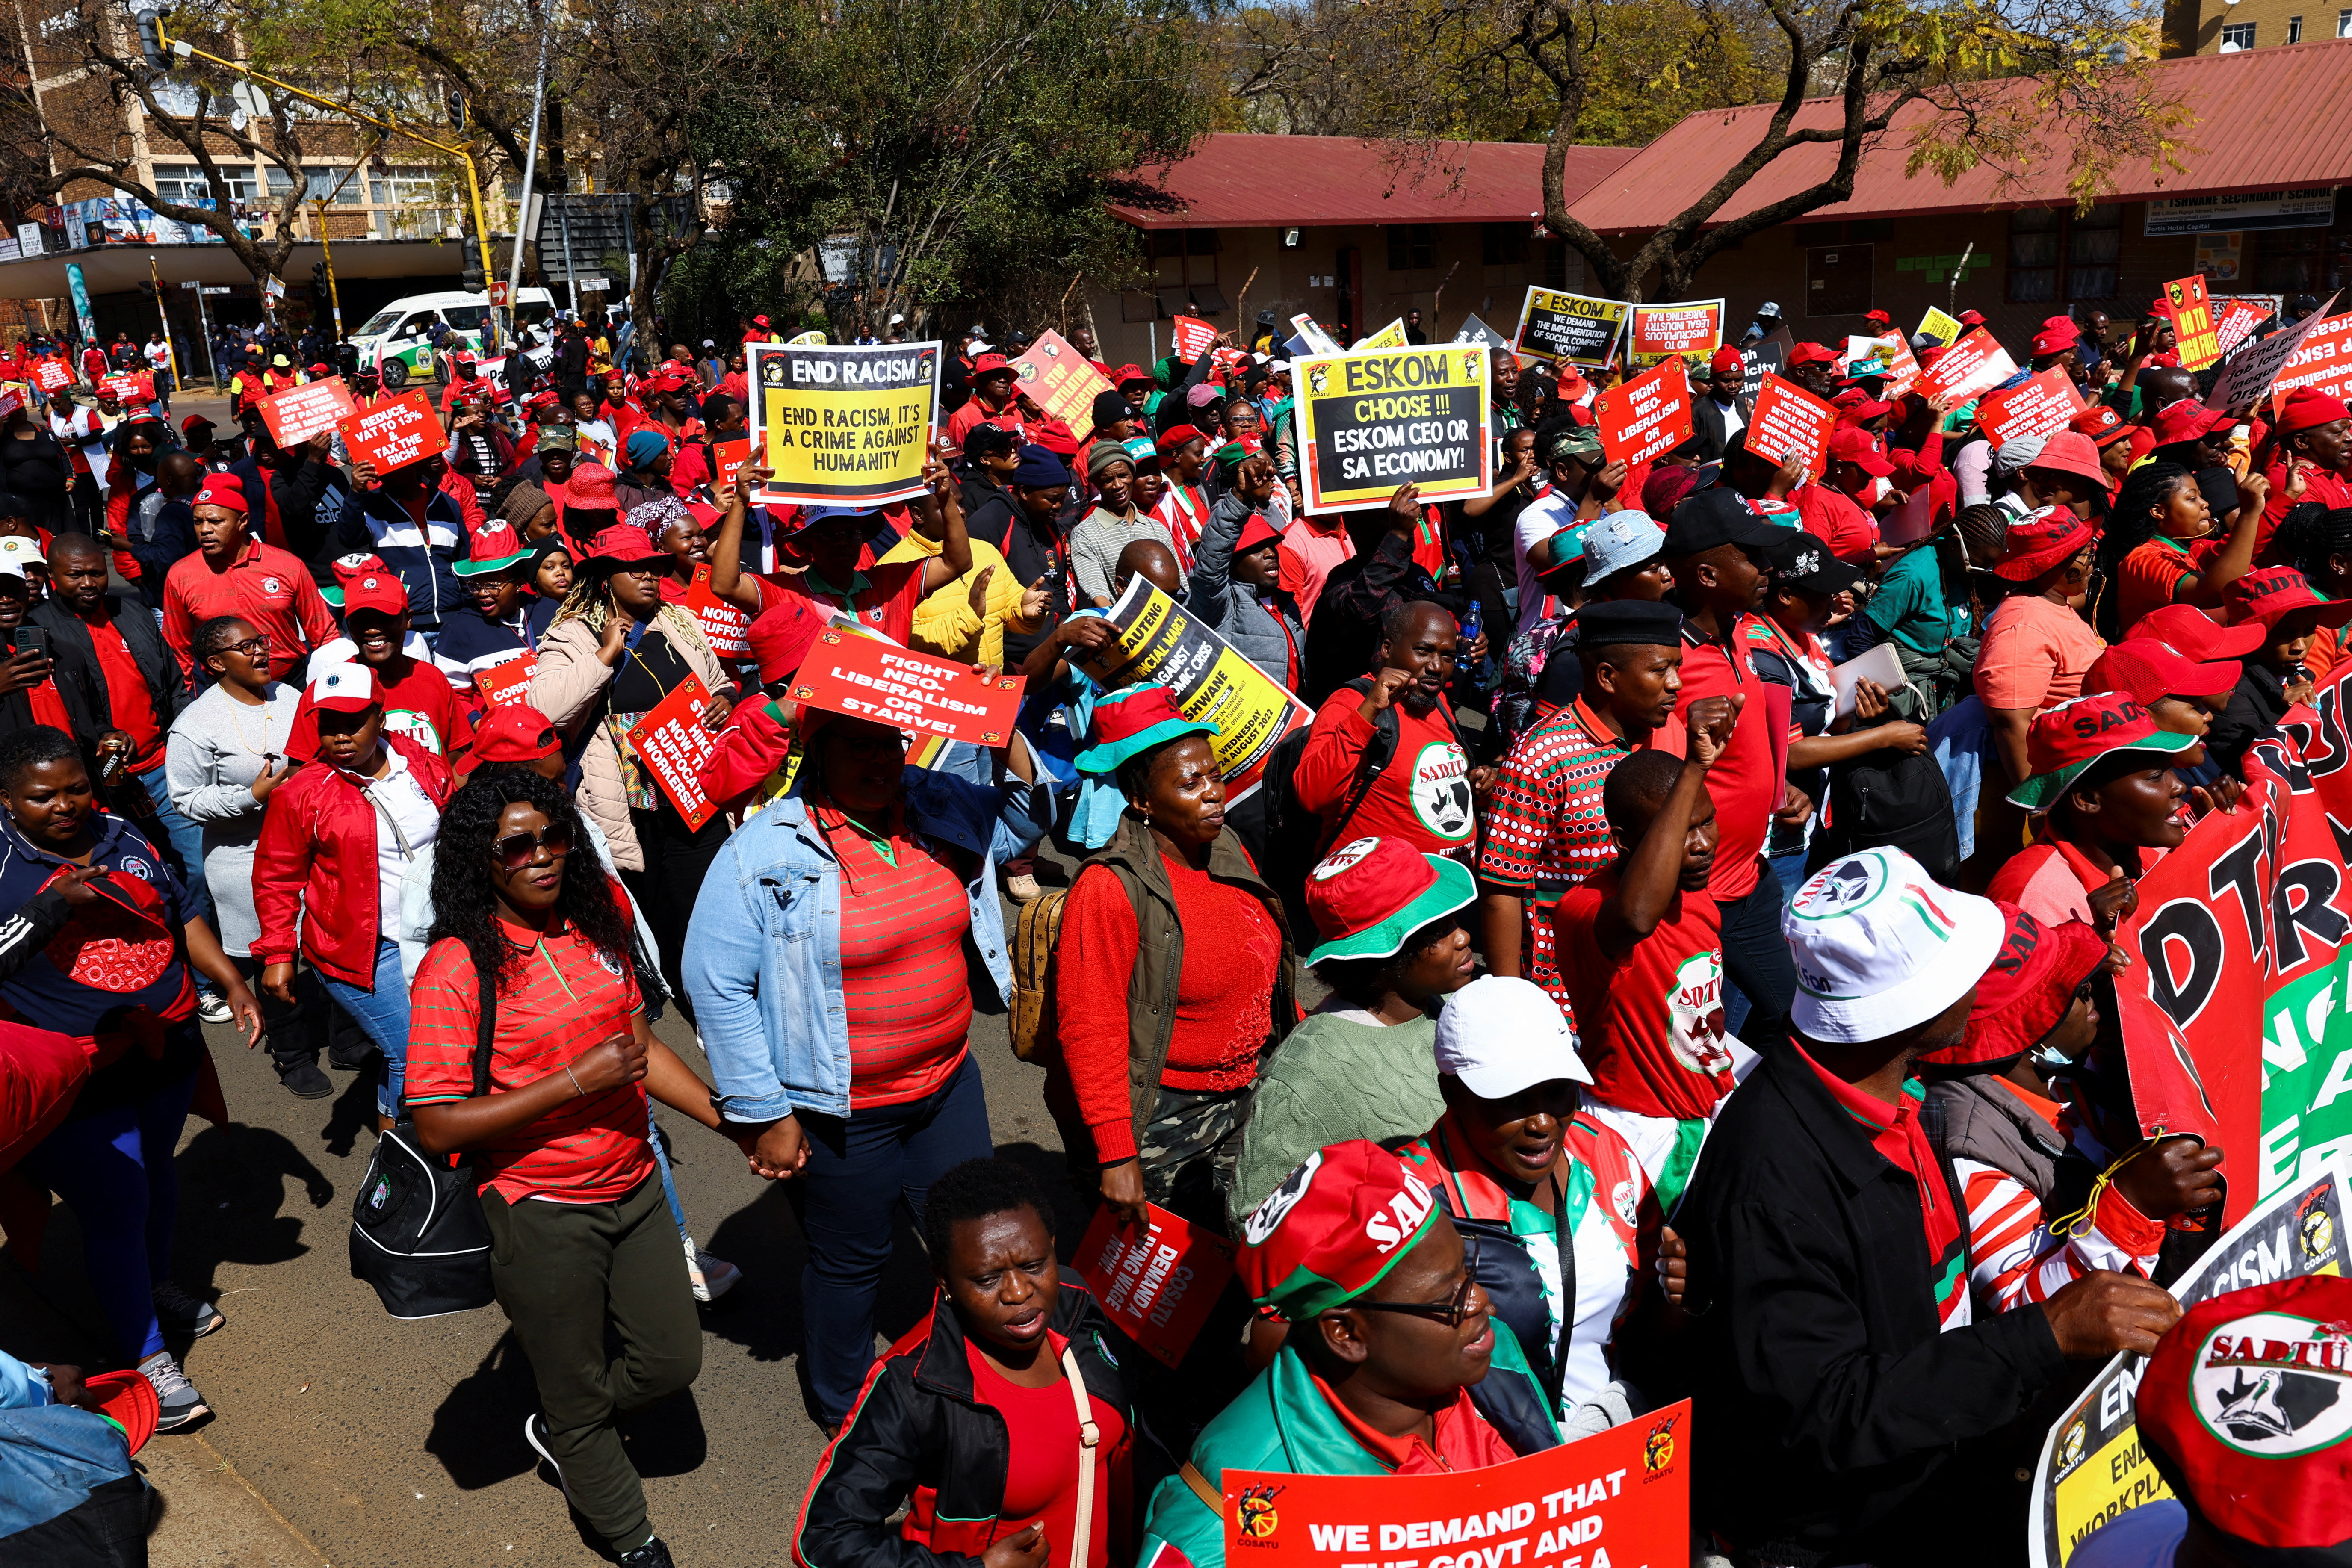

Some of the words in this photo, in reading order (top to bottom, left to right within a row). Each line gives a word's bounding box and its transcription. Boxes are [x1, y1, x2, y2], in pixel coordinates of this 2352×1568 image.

[1550, 295, 1606, 317] ESKOM
[1191, 324, 1207, 332] DEMAND
[1537, 320, 1551, 330] THE
[1551, 323, 1607, 339] IMPLEMENTATION
[1554, 314, 1566, 323] WE
[1566, 316, 1596, 328] DEMAND
[1644, 320, 1685, 332] INDUSTRY
[1645, 328, 1708, 341] UNSCRUPULOUS
[2178, 310, 2192, 336] NO
[2192, 306, 2208, 331] TO
[1534, 330, 1544, 338] OF
[1544, 331, 1570, 343] SOCIAL
[1571, 337, 1604, 347] COMPACT
[2178, 339, 2201, 366] HIGH
[2200, 331, 2220, 358] FUEL
[2246, 340, 2277, 361] End
[792, 360, 837, 384] END
[843, 358, 916, 383] RACISM
[1924, 338, 1975, 378] TRANSPORT!
[1934, 349, 1984, 385] ACCESSIBLE
[1938, 350, 1970, 372] PUBLIC
[1962, 358, 1986, 375] SAFE
[1043, 363, 1068, 389] STOP
[1345, 354, 1449, 392] ESKOM
[1944, 371, 1964, 385] AND
[274, 386, 329, 407] WORKERS
[1044, 363, 1093, 414] MUTILATING
[1628, 378, 1661, 405] FIGHT
[2003, 384, 2042, 409] COSATU
[278, 404, 300, 416] ARE
[303, 393, 334, 408] TIRED
[281, 413, 296, 424] OF
[298, 402, 339, 419] PAYING
[360, 403, 408, 429] REDUCE
[783, 406, 818, 426] END
[824, 408, 894, 428] RACISM,
[899, 404, 920, 422] IT'S
[1355, 395, 1431, 422] CHOOSE
[1436, 394, 1450, 416] !!!
[1635, 399, 1661, 418] NEO-
[1774, 386, 1793, 399] STOP
[1793, 396, 1826, 419] COERCING
[1780, 399, 1808, 419] VICTIMS
[1808, 416, 1817, 425] TO
[2008, 392, 2045, 416] REJECT
[278, 422, 302, 434] FOR
[304, 413, 333, 426] MESS
[334, 407, 348, 416] AT
[355, 428, 378, 443] VAT
[378, 419, 396, 434] TO
[397, 409, 423, 427] 13%
[1617, 398, 1680, 443] LIBERALISM
[1765, 413, 1789, 431] COURT
[1789, 425, 1807, 440] WITH
[1807, 437, 1820, 448] THE
[1771, 405, 1797, 424] SETTLE
[1797, 419, 1811, 431] OUT
[1811, 428, 1820, 437] OF
[2001, 421, 2036, 441] ESKOM
[2042, 407, 2056, 419] NO
[2056, 400, 2071, 410] TO
[373, 442, 399, 459] TAX
[399, 432, 424, 447] THE
[388, 431, 399, 442] &
[782, 428, 795, 447] A
[801, 430, 856, 450] CRIME
[863, 425, 920, 449] AGAINST
[1334, 424, 1405, 453] ESKOM
[1409, 421, 1444, 445] CEO
[1447, 419, 1469, 442] OR
[1645, 426, 1660, 443] OR
[1760, 422, 1810, 455] PERPETRATORS,
[1811, 449, 1818, 459] IT
[1761, 433, 1769, 442] IS
[387, 446, 419, 466] RICH!
[813, 449, 900, 472] HUMANITY
[1632, 432, 1675, 465] STARVE!
[1342, 456, 1371, 480] SA
[1374, 447, 1465, 477] ECONOMY!
[702, 606, 737, 625] NOW,
[1118, 602, 1162, 656] GAUTENG
[1117, 644, 1170, 687] PROVINCIAL
[1162, 614, 1188, 647] MARCH
[1191, 641, 1213, 670] CRISIS
[880, 653, 959, 681] FIGHT
[1152, 644, 1191, 685] AGAINST
[830, 667, 988, 716] LIBERALISM
[883, 667, 945, 692] NEO-
[885, 696, 924, 715] OR
[1217, 689, 1232, 706] POINT:
[1219, 710, 1226, 718] IN
[1238, 680, 1246, 693] WALT
[1226, 697, 1244, 720] TSHWANE
[842, 697, 957, 734] STARVE!
[667, 718, 695, 759] NOW,
[1218, 709, 1262, 755] WEDNESDAY
[1218, 759, 1230, 768] 24
[1230, 729, 1260, 760] AUGUST
[1259, 709, 1274, 729] 2022
[102, 753, 120, 777] STONEY
[643, 738, 697, 814] WORKERS!!!
[654, 727, 706, 804] SUFFOCATE
[1439, 846, 1462, 856] RTGM
[1464, 840, 1474, 850] 2018
[2303, 1245, 2337, 1271] COSATU
[1133, 1243, 1179, 1308] DEMAND
[1105, 1269, 1134, 1312] WAGE
[1149, 1265, 1194, 1328] COSATU
[1127, 1302, 1143, 1318] A
[2210, 1335, 2350, 1370] SADTU
[1643, 1465, 1675, 1485] COSATU
[2054, 1451, 2086, 1484] COSATU
[1309, 1524, 1371, 1553] WE
[1379, 1501, 1536, 1551] DEMAND
[1542, 1468, 1627, 1518] THAT
[1237, 1538, 1279, 1549] COSATU
[1534, 1515, 1603, 1559] AND
